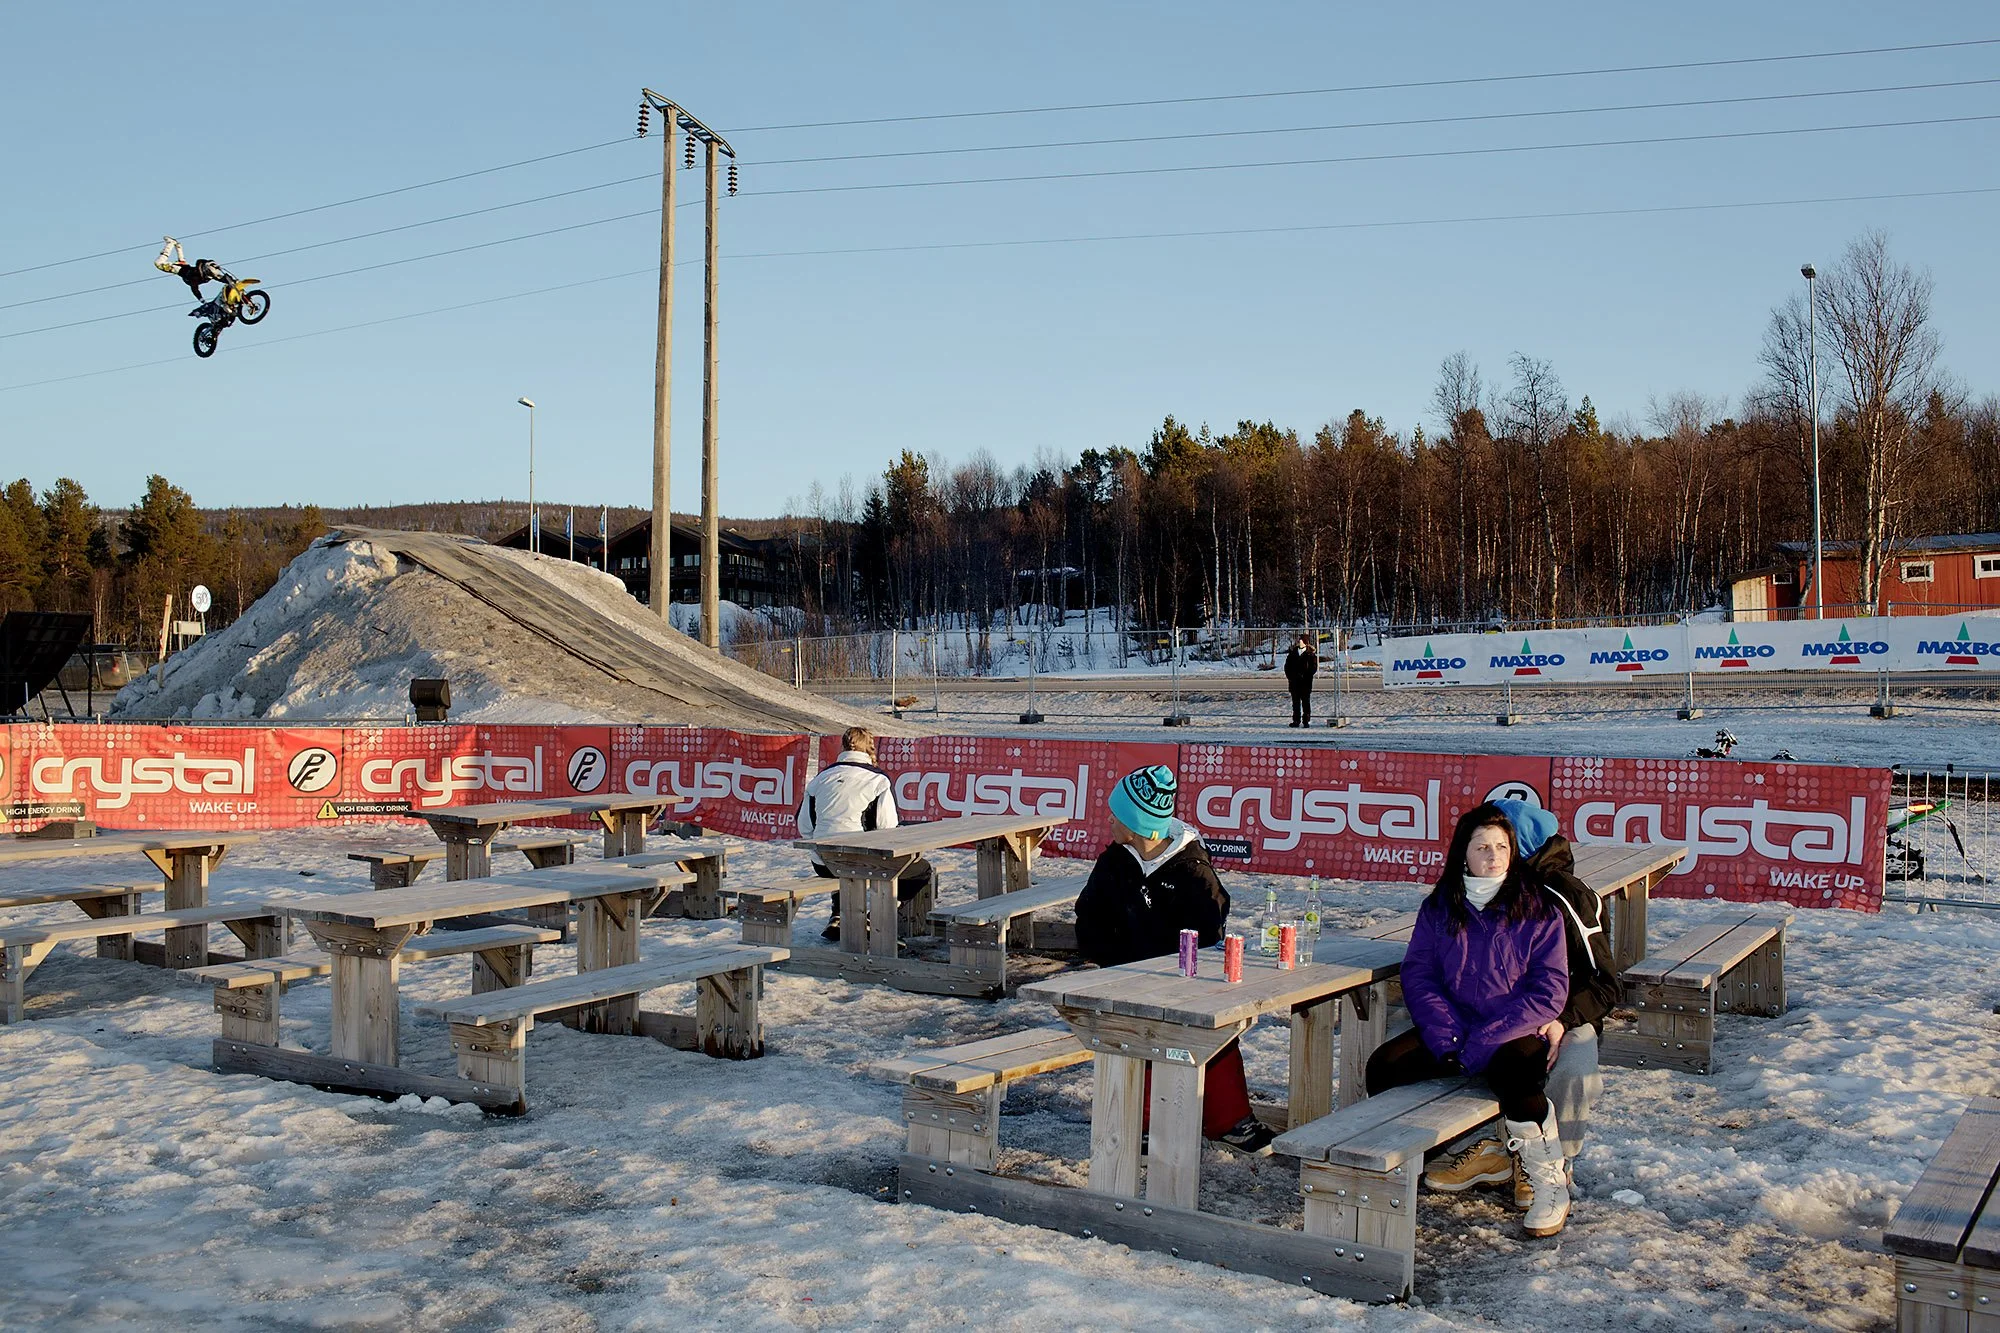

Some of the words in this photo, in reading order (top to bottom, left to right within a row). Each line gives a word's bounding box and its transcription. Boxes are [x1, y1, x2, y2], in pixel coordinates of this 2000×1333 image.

[1590, 648, 1669, 664] MAXBO
[1695, 644, 1776, 659] MAXBO
[1802, 641, 1889, 656] MAXBO
[1392, 657, 1467, 671] MAXBO
[1489, 653, 1565, 668] MAXBO
[32, 748, 255, 809] crystal
[360, 746, 543, 807] crystal
[625, 755, 795, 813] crystal
[898, 764, 1090, 820] crystal
[28, 806, 55, 815] ENERGY
[56, 806, 81, 814] DRINK
[189, 801, 234, 813] WAKE
[336, 805, 355, 813] HIGH
[386, 804, 409, 812] DRINK
[741, 809, 776, 825] WAKE
[1196, 779, 1441, 852] crystal
[1573, 796, 1867, 875] crystal
[1221, 844, 1248, 854] DRINK
[1364, 847, 1414, 864] WAKE
[1770, 871, 1831, 889] WAKE
